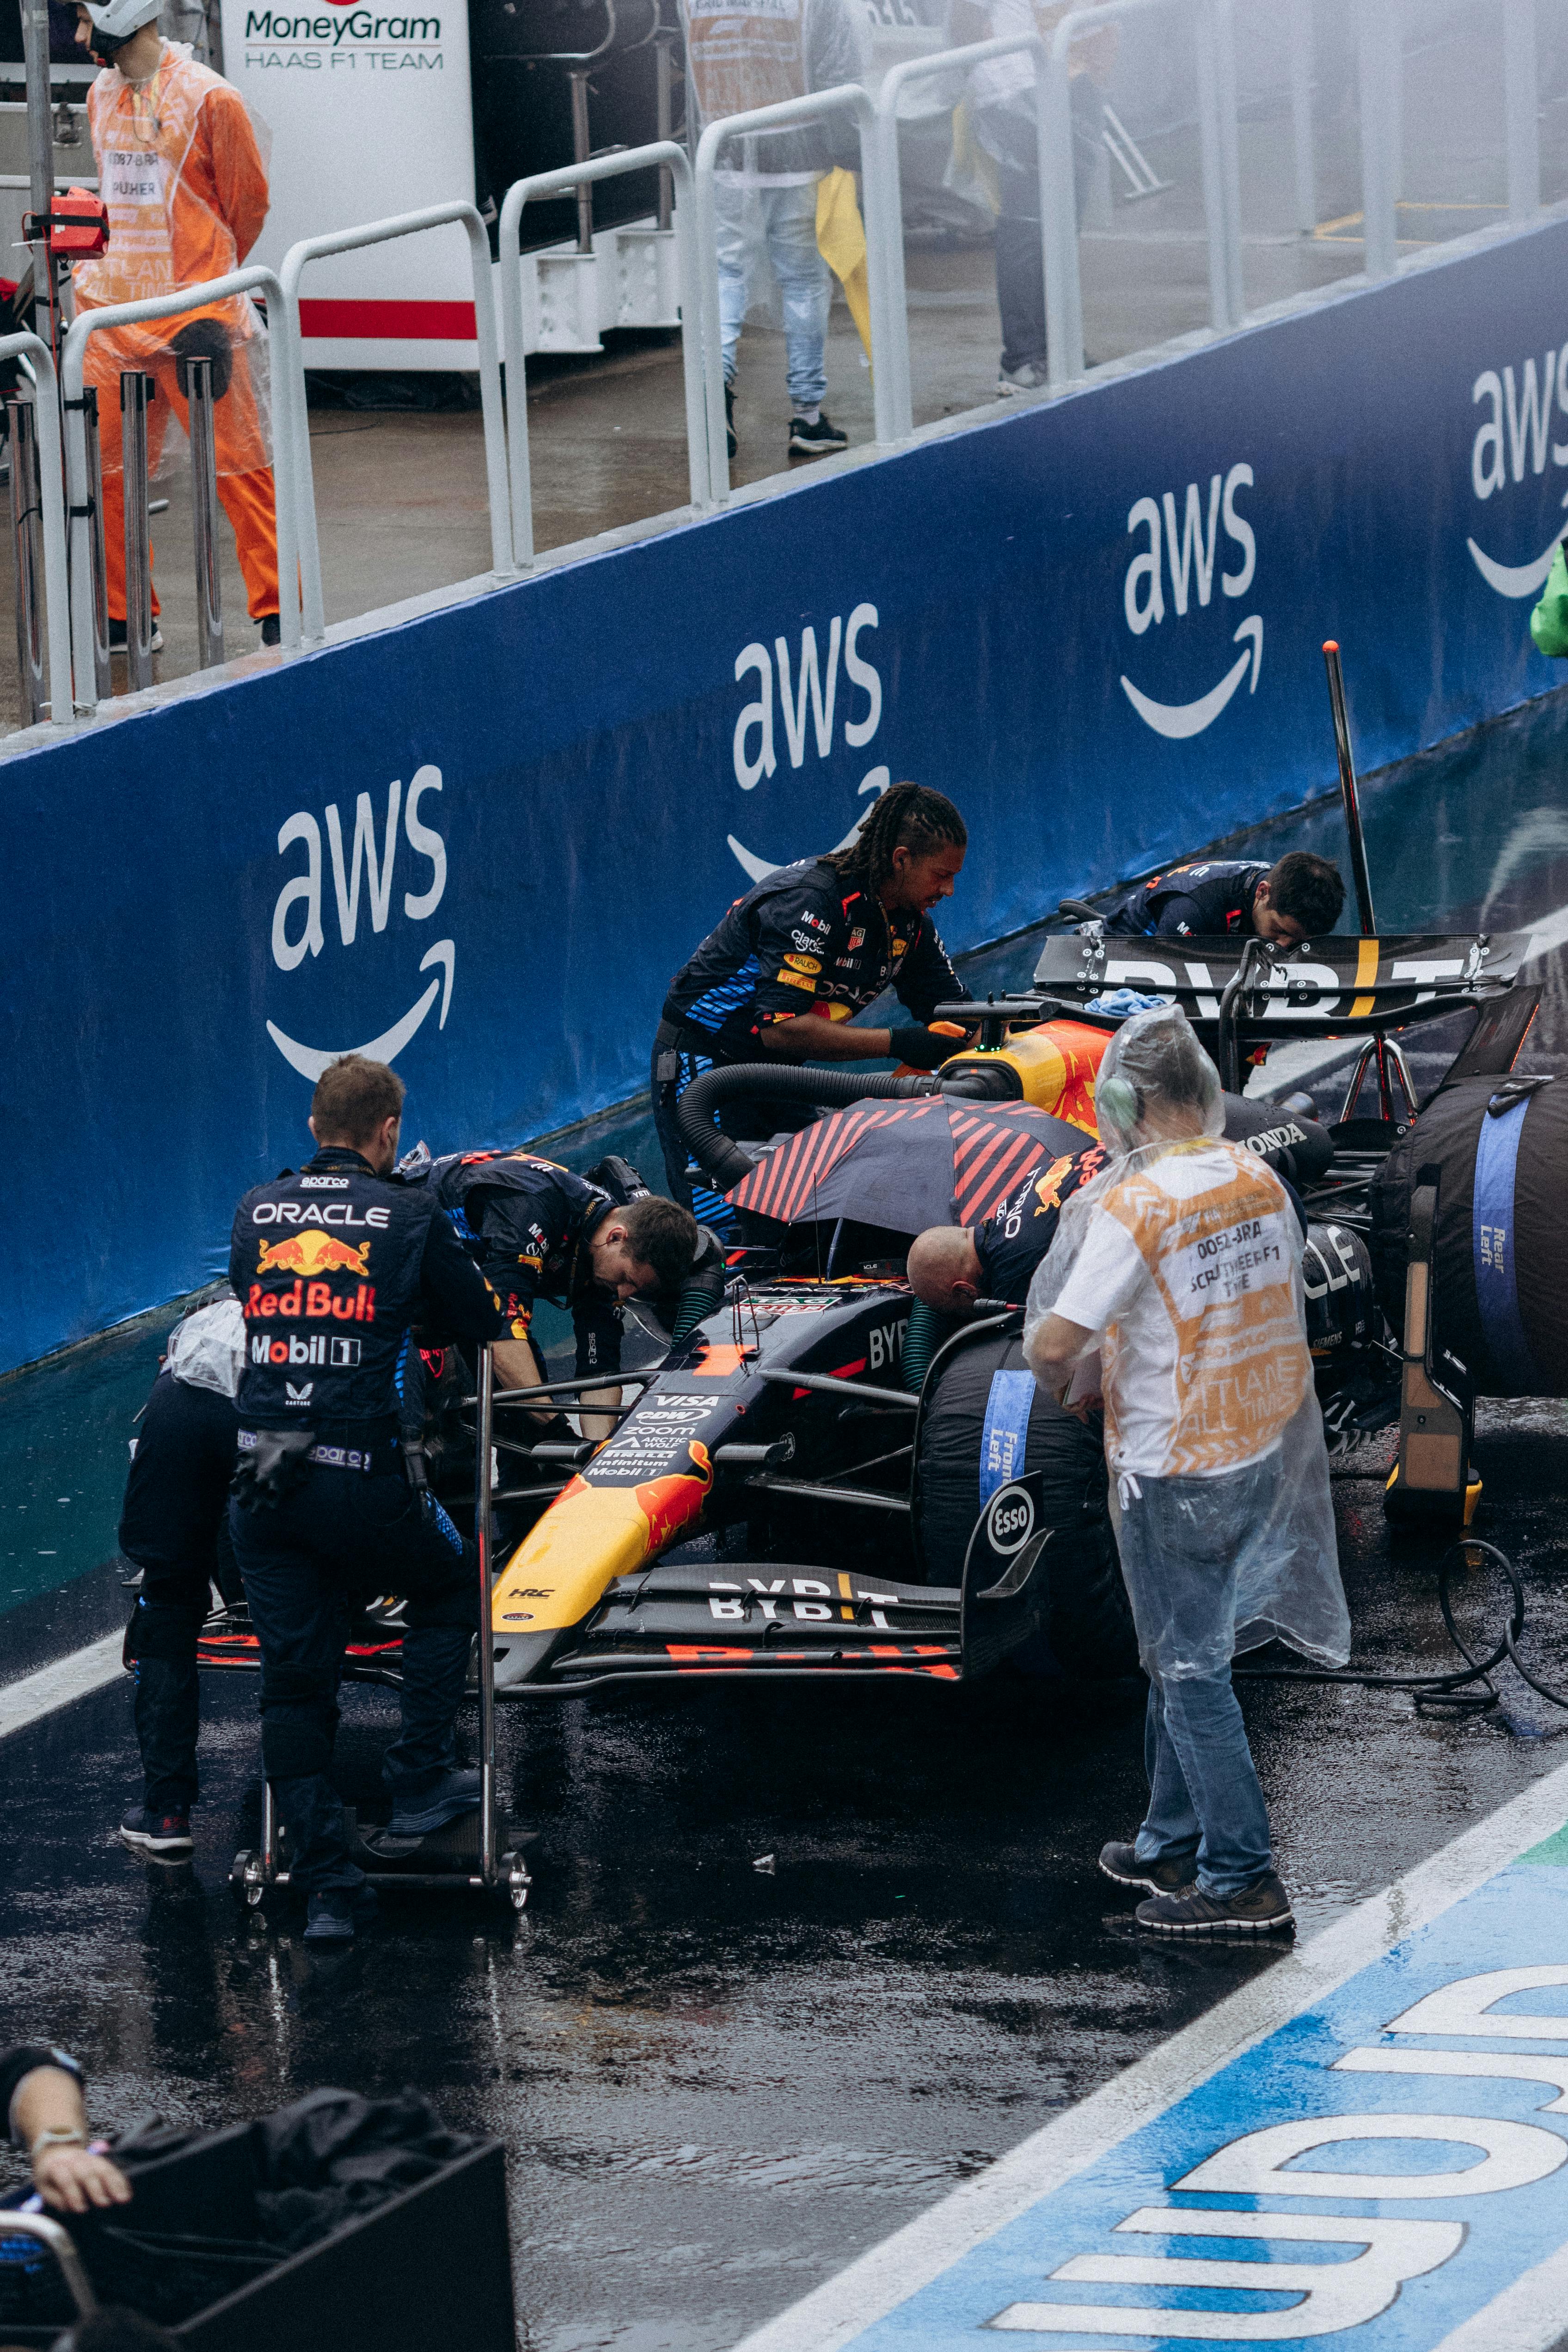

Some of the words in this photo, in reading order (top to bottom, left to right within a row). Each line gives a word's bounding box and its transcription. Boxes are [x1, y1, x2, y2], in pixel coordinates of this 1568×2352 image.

[246, 10, 441, 46] MoneyGram
[246, 52, 322, 69] HAAS
[331, 53, 355, 69] F1
[364, 53, 443, 69] TEAM
[1125, 463, 1256, 634] aws
[734, 603, 882, 790] aws
[272, 765, 447, 971] aws
[801, 910, 831, 935] Mobil
[794, 956, 818, 971] RAUCH
[781, 972, 813, 990] PIRELLI
[300, 1176, 349, 1188] sparco
[253, 1203, 391, 1228] ORACLE
[1263, 1245, 1280, 1261] F1
[1481, 1225, 1493, 1266] Left
[1494, 1227, 1506, 1274] Rear
[245, 1279, 303, 1318] Red
[306, 1281, 376, 1322] Bull
[252, 1335, 325, 1364] Mobil
[340, 1341, 350, 1363] 1
[653, 1396, 719, 1406] VISA
[635, 1411, 695, 1420] CDW
[1180, 1412, 1238, 1438] ALL
[623, 1427, 696, 1435] zoom
[603, 1450, 678, 1458] PIRELLI
[988, 1428, 1004, 1472] Left
[508, 1589, 556, 1597] HRC
